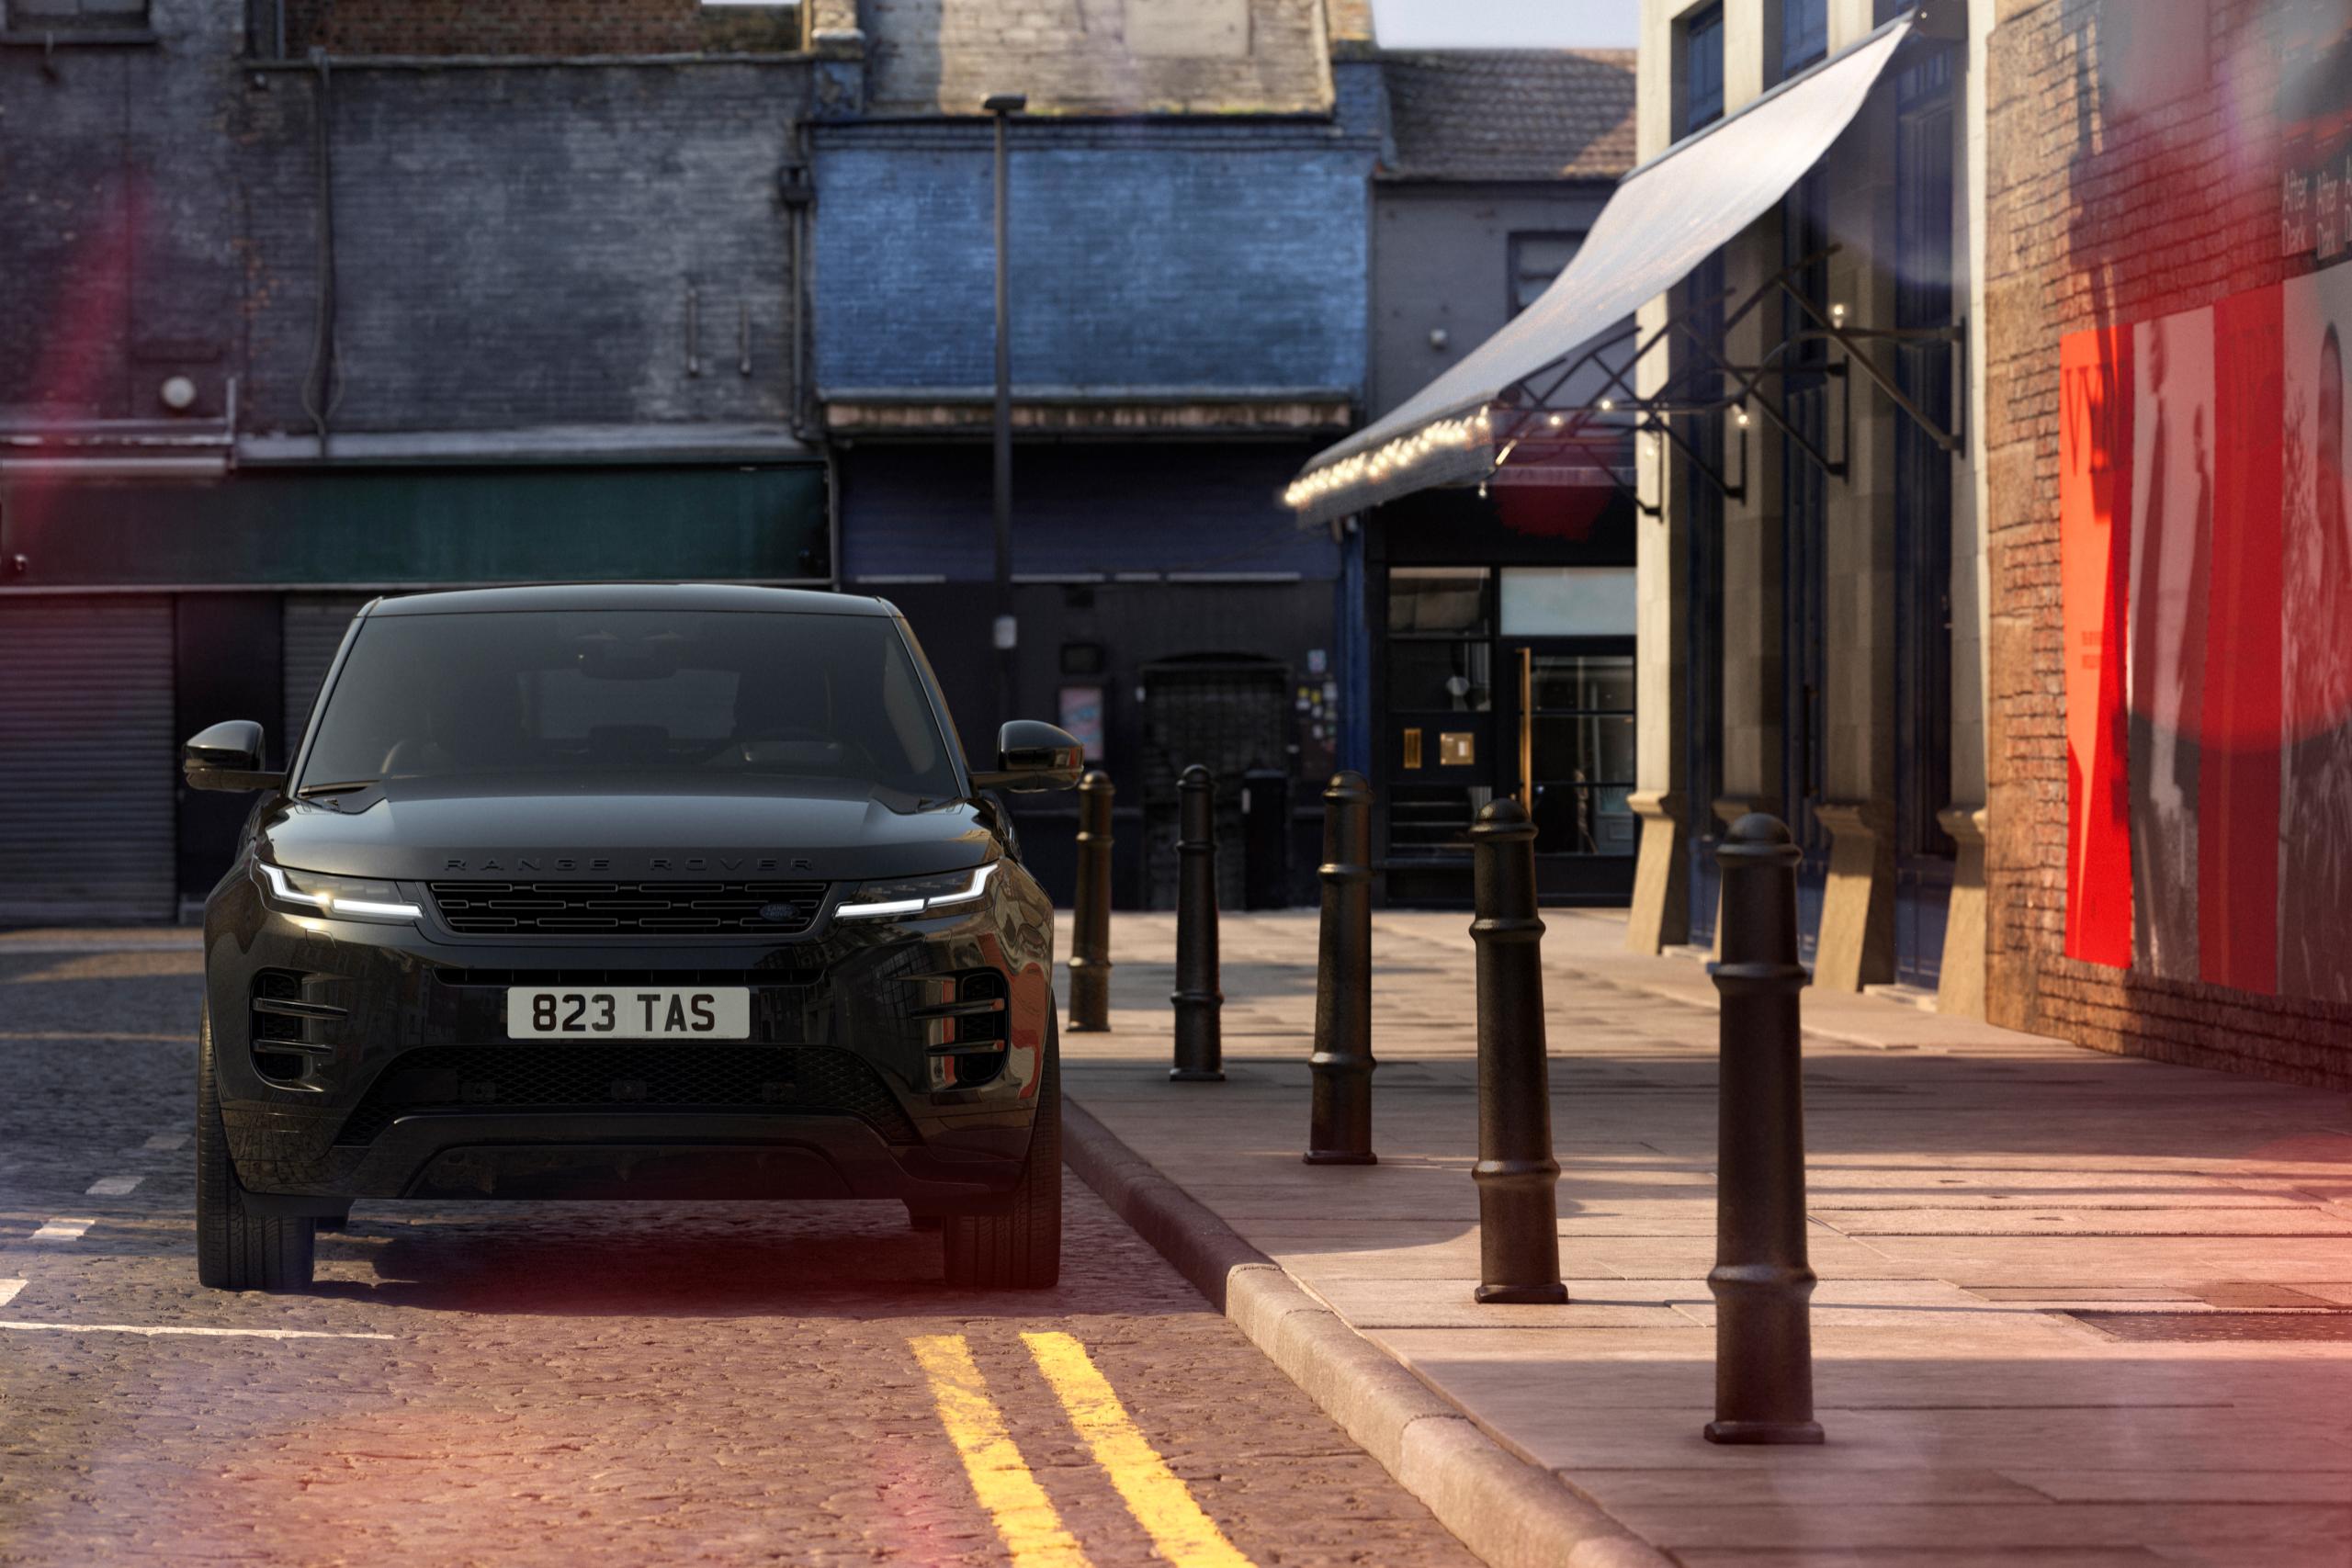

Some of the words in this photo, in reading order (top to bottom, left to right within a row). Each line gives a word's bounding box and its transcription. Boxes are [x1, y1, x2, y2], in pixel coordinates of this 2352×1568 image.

[445, 858, 611, 871] RANGE
[649, 858, 815, 871] ROVER
[532, 993, 616, 1032] 823
[637, 993, 716, 1032] TAS
